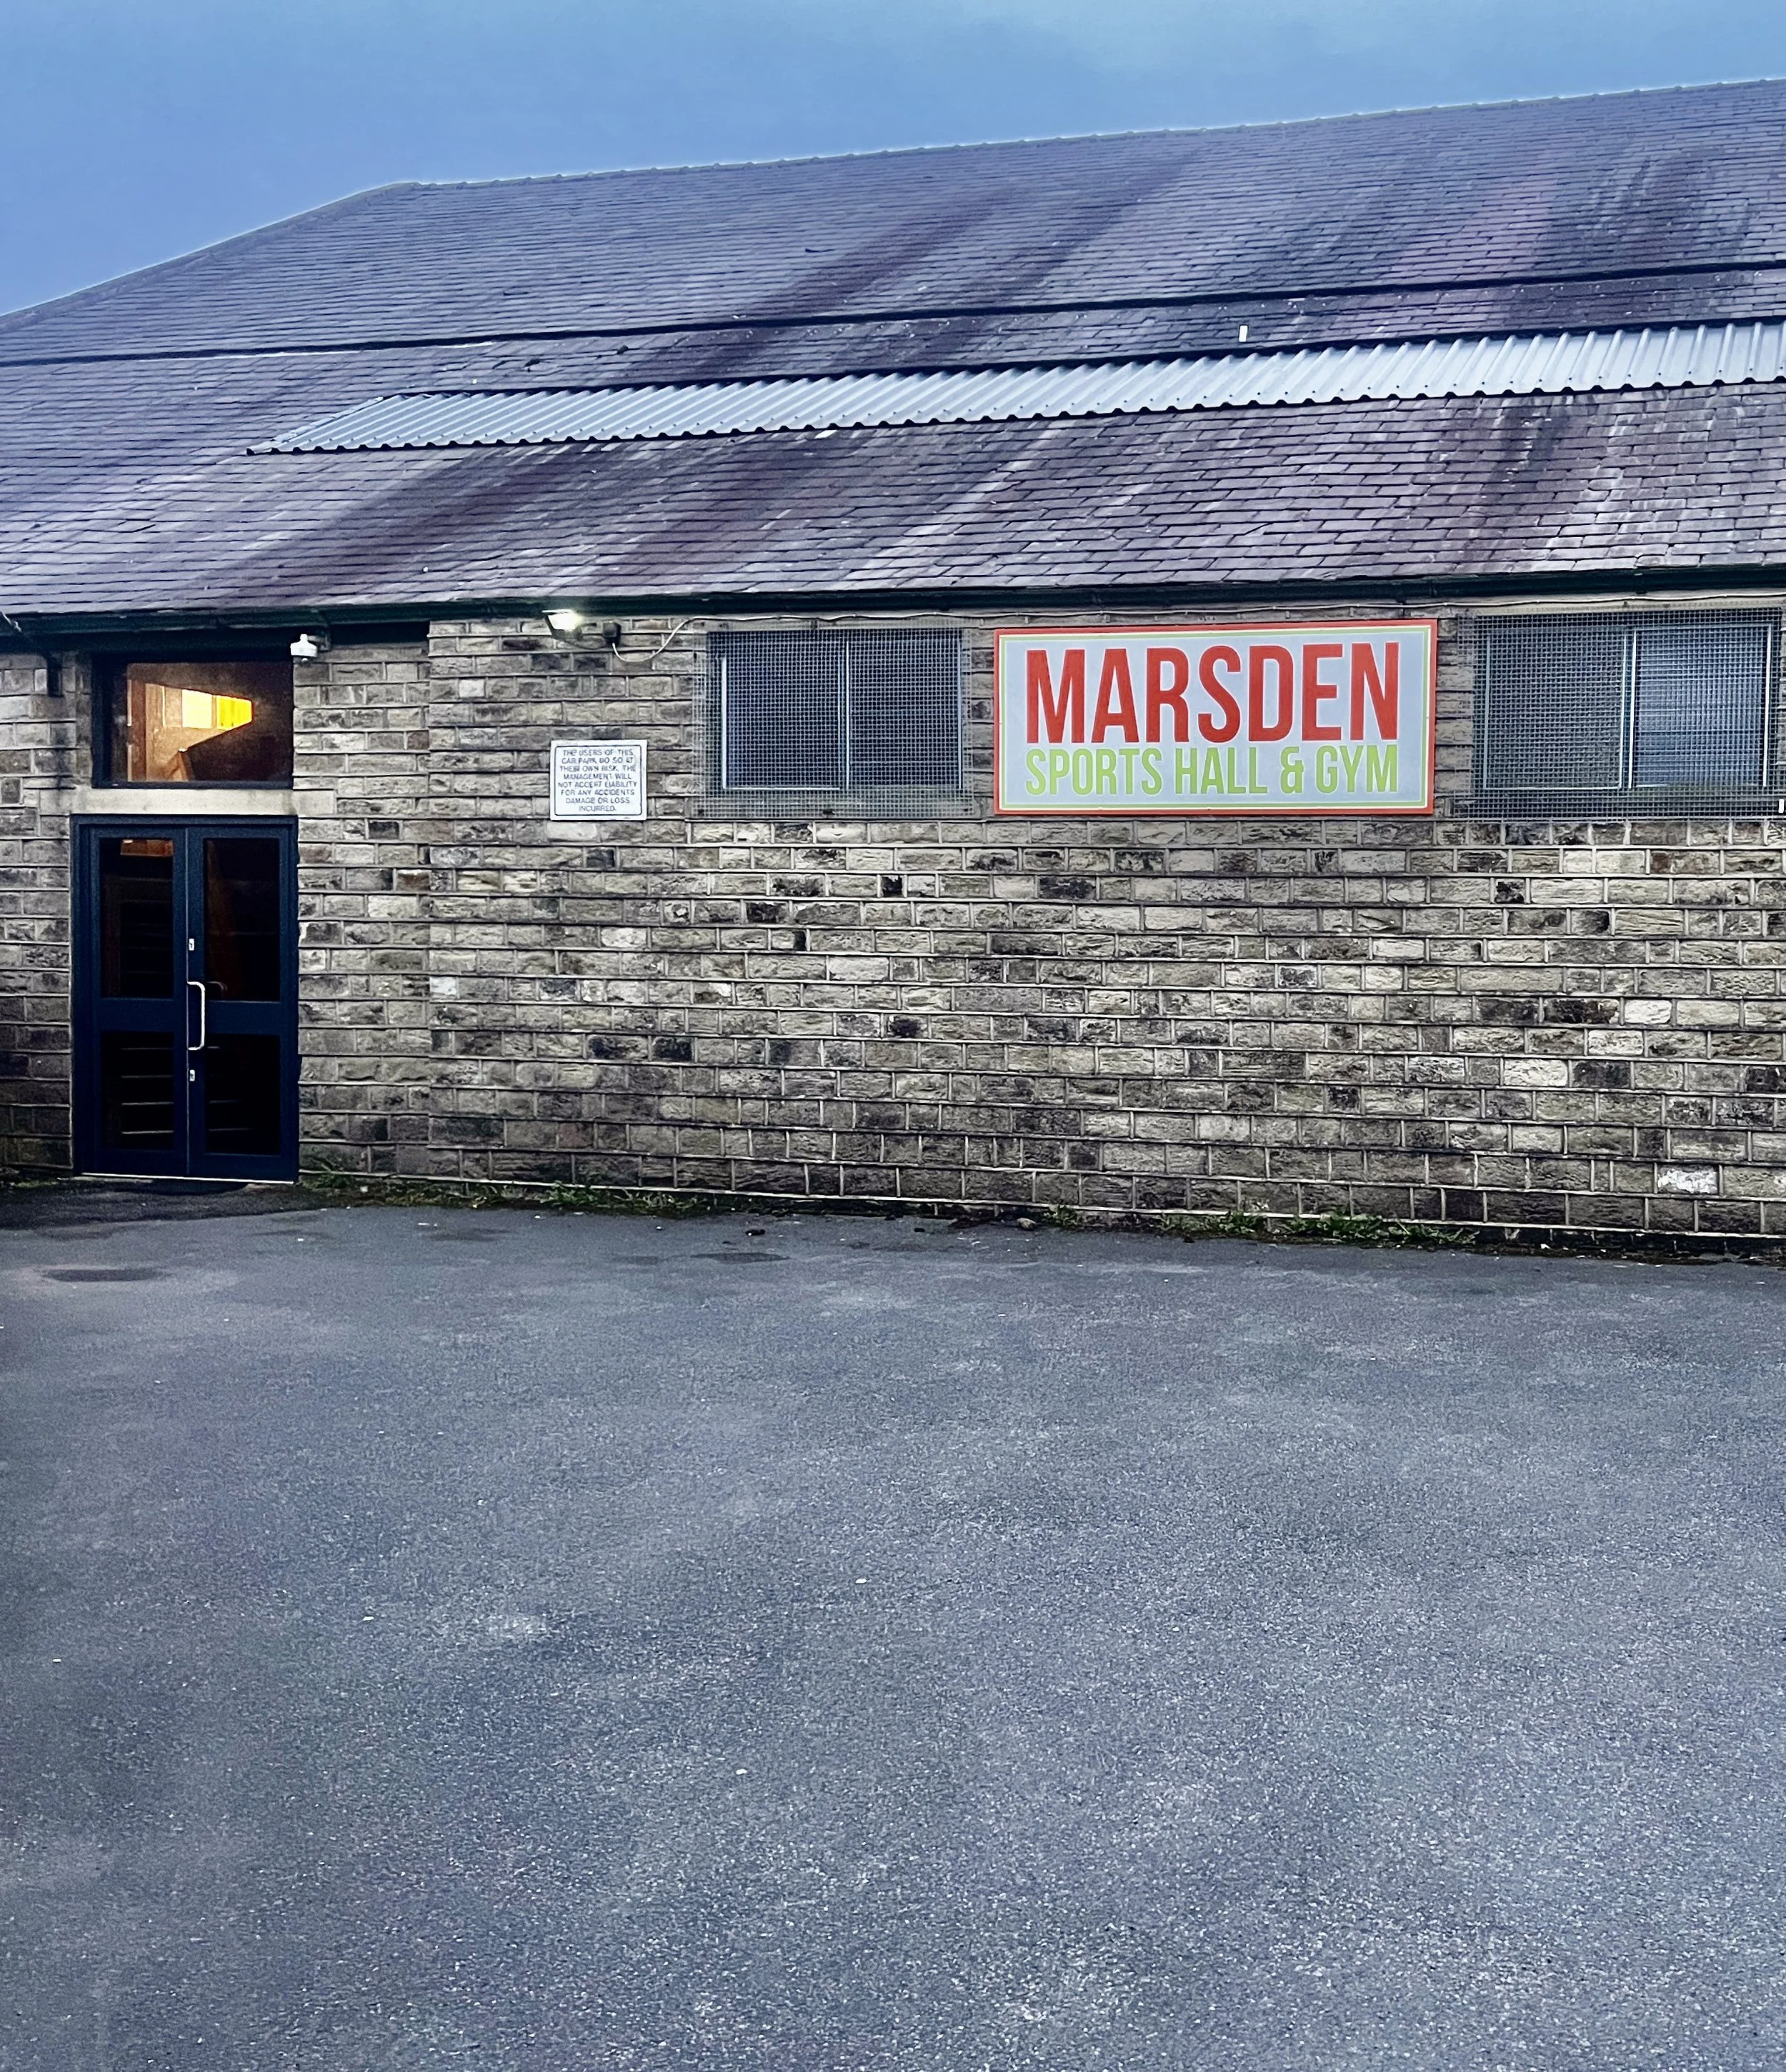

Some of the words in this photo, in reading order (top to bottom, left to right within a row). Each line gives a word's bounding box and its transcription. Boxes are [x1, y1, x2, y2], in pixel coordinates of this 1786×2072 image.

[1026, 642, 1400, 744] MARSDEN
[1025, 747, 1163, 796] SPORTS
[1174, 746, 1268, 794] HALL
[1280, 746, 1304, 794] &
[1315, 744, 1398, 793] GYM
